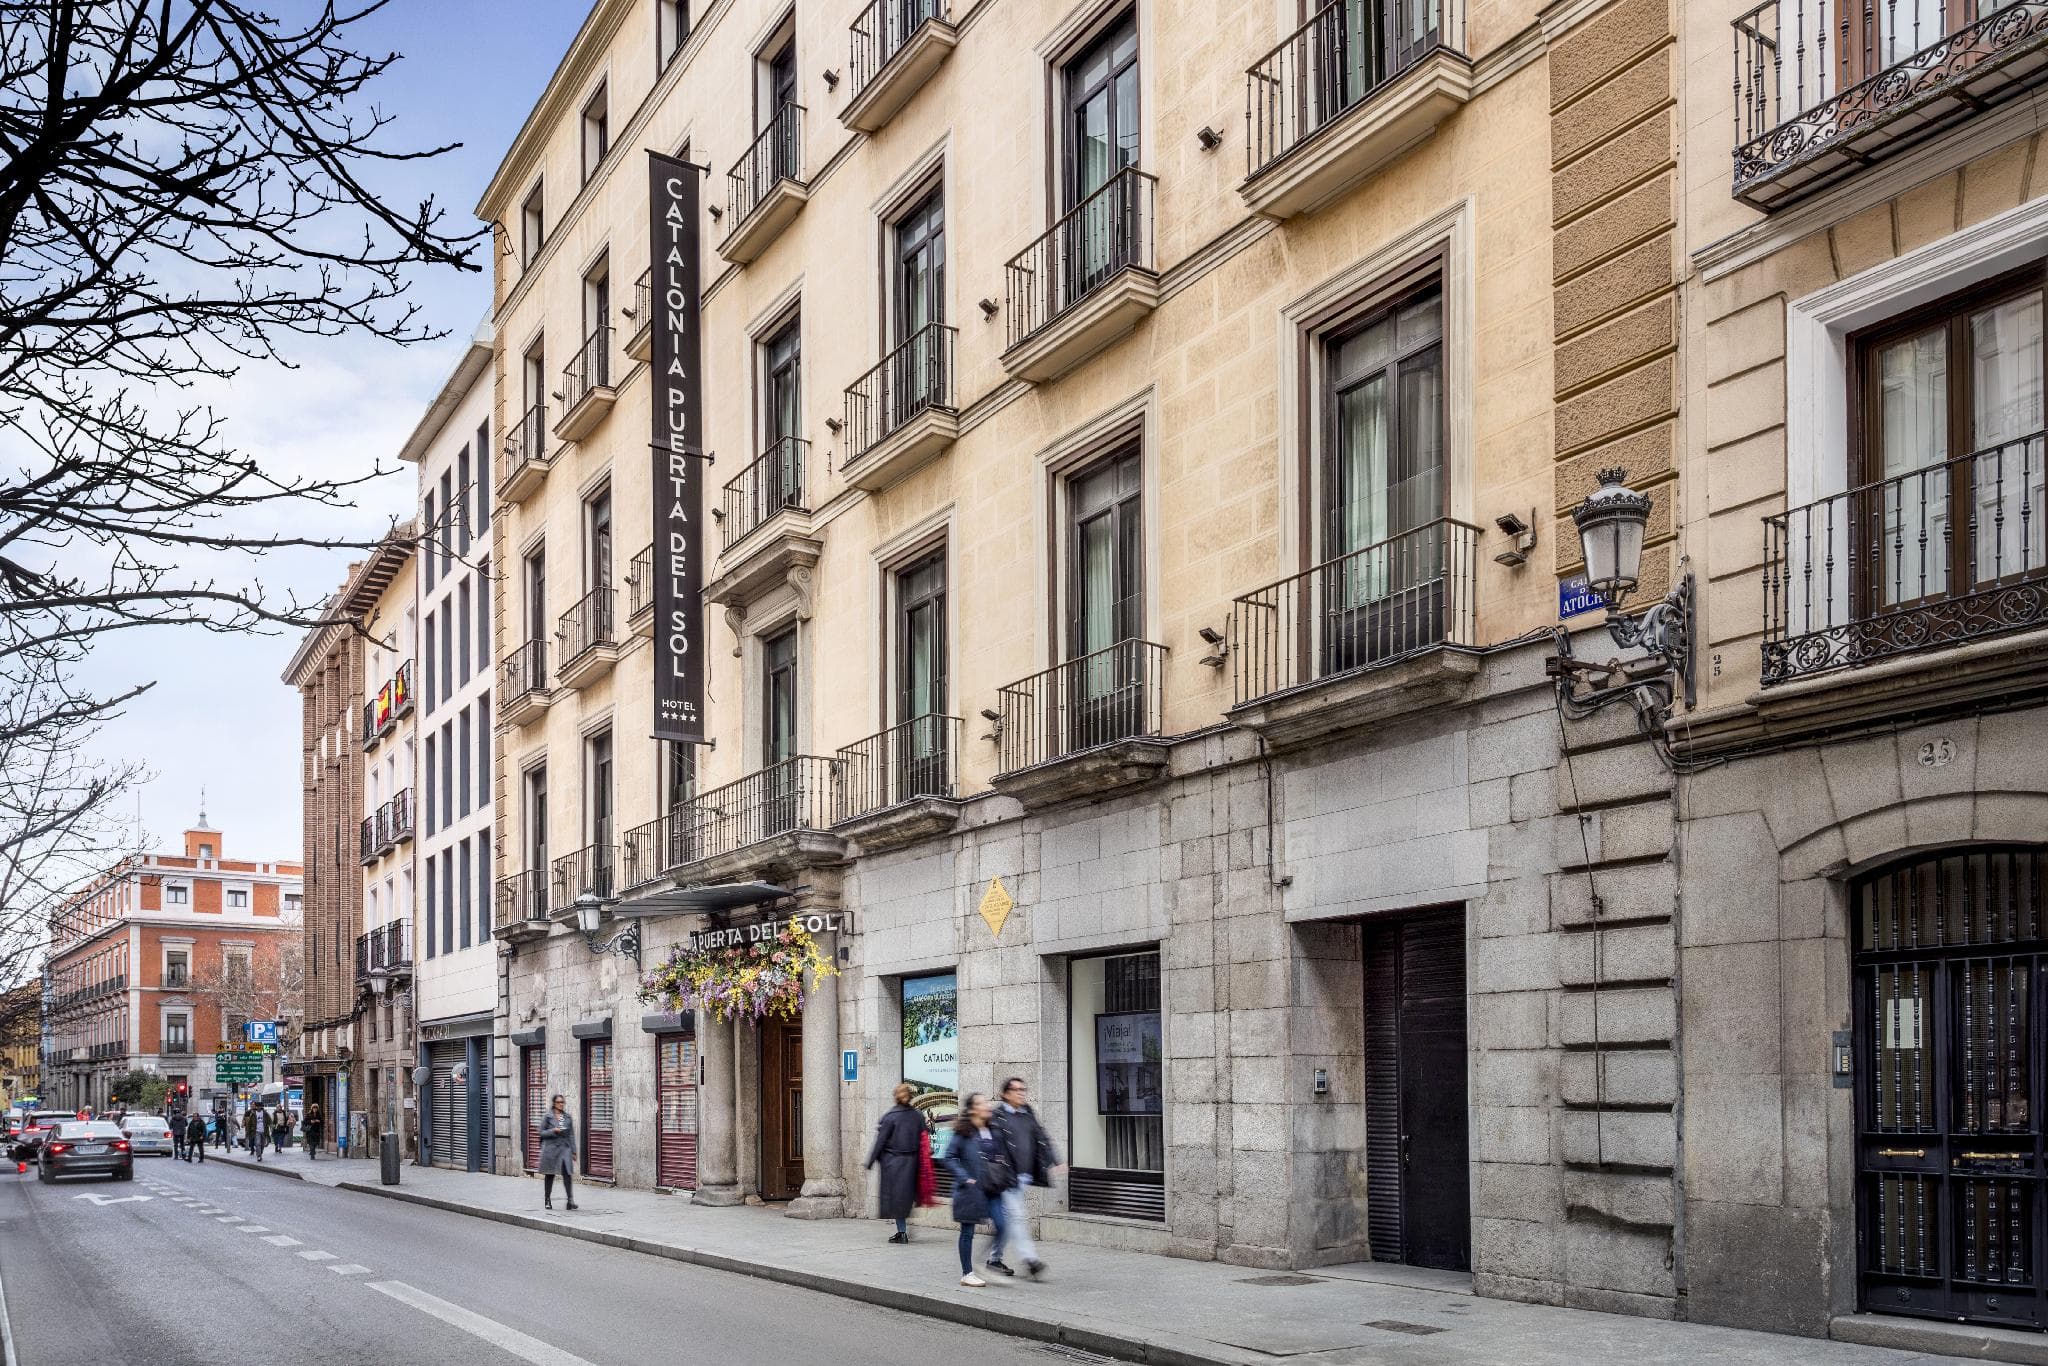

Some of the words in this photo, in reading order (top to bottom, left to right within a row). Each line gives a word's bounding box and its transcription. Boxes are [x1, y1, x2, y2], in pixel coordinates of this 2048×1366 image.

[666, 178, 686, 378] CATALONIA
[668, 388, 688, 522] PUERTA
[670, 532, 687, 599] DEL
[669, 612, 688, 678] SOL
[661, 698, 696, 711] HOTEL
[698, 927, 744, 953] PUERTA
[750, 921, 782, 942] DEL
[254, 1023, 265, 1038] P
